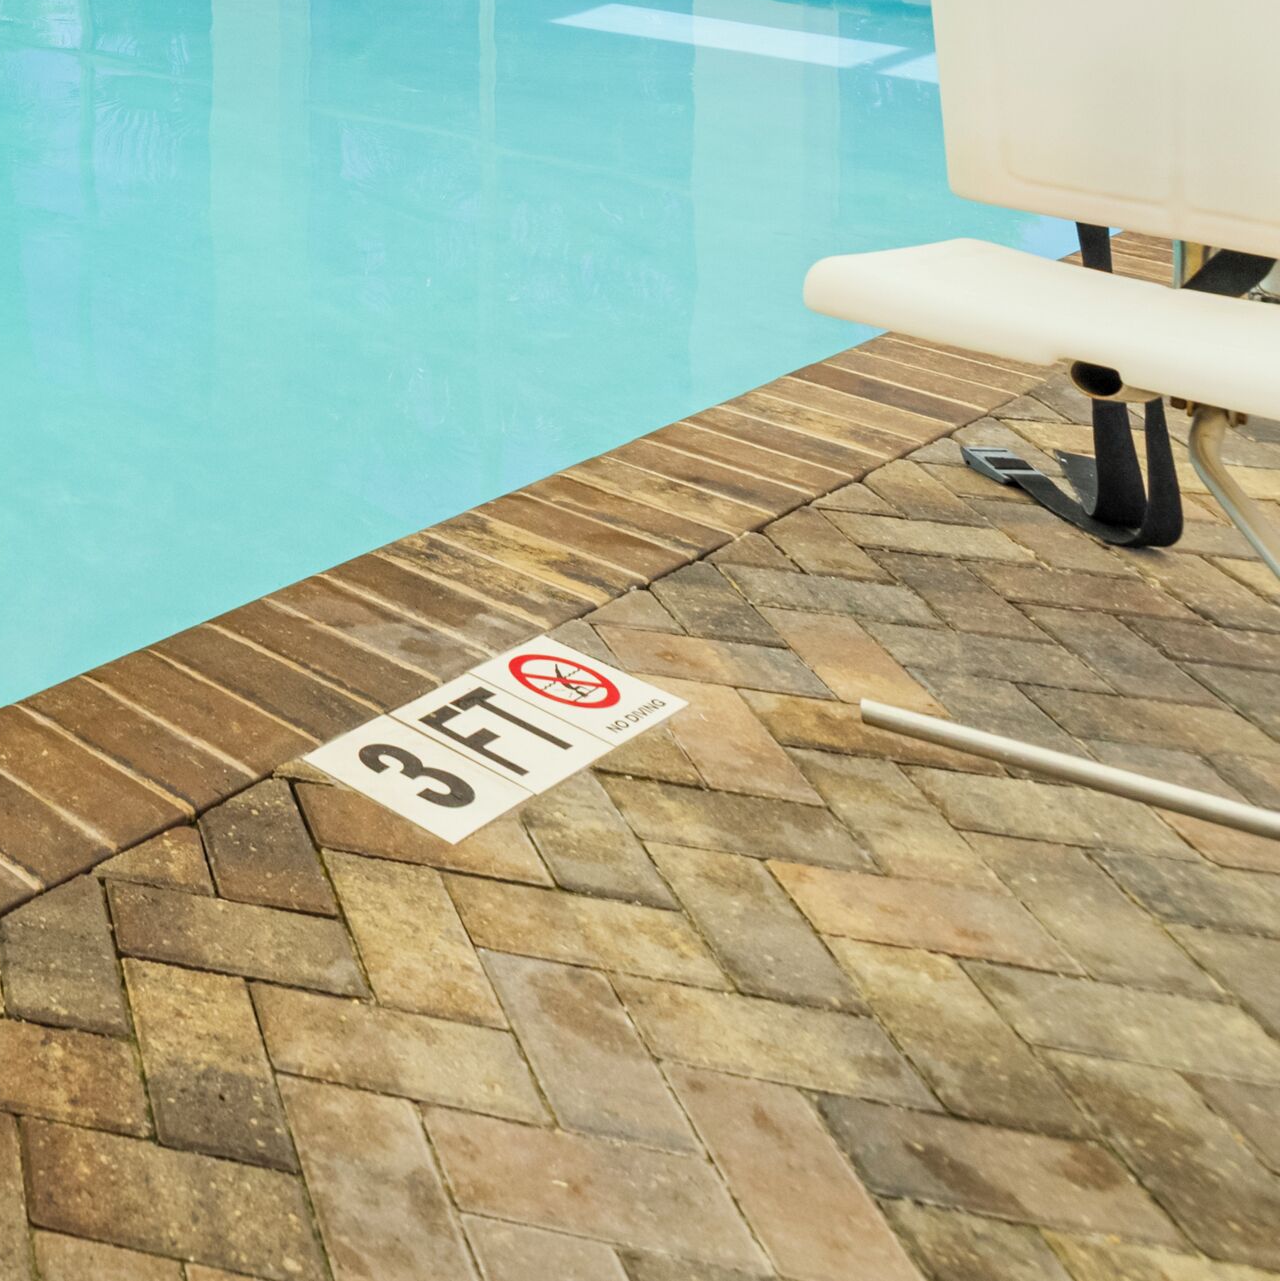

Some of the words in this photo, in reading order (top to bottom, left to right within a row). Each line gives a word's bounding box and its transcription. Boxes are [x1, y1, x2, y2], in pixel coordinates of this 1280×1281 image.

[358, 744, 476, 808] 3
[418, 686, 574, 776] FT
[606, 720, 629, 733] NO
[625, 699, 666, 723] DIVING
